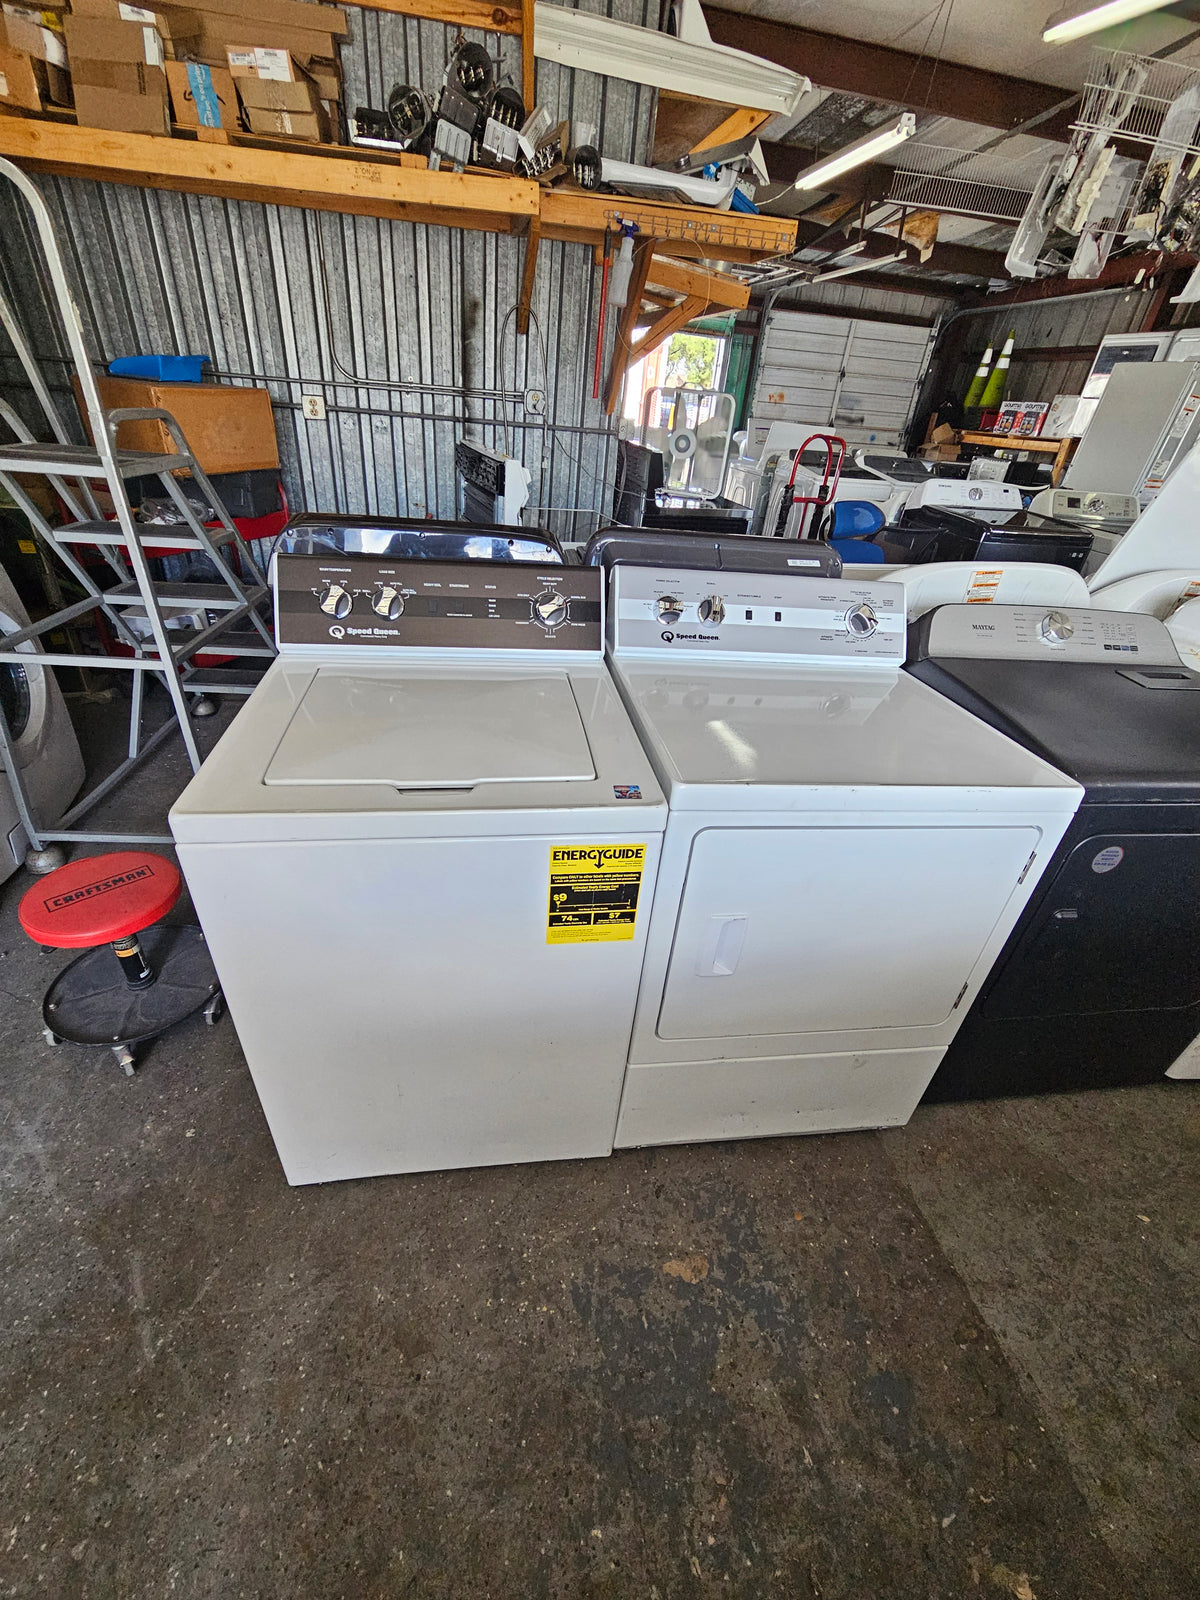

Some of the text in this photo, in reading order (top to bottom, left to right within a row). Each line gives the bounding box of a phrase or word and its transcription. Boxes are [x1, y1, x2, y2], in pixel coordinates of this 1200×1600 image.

[346, 627, 372, 635] Speed
[553, 848, 643, 862] ENERGYGUIDE
[52, 870, 147, 907] CRAFTSMAN
[553, 893, 567, 902] $9
